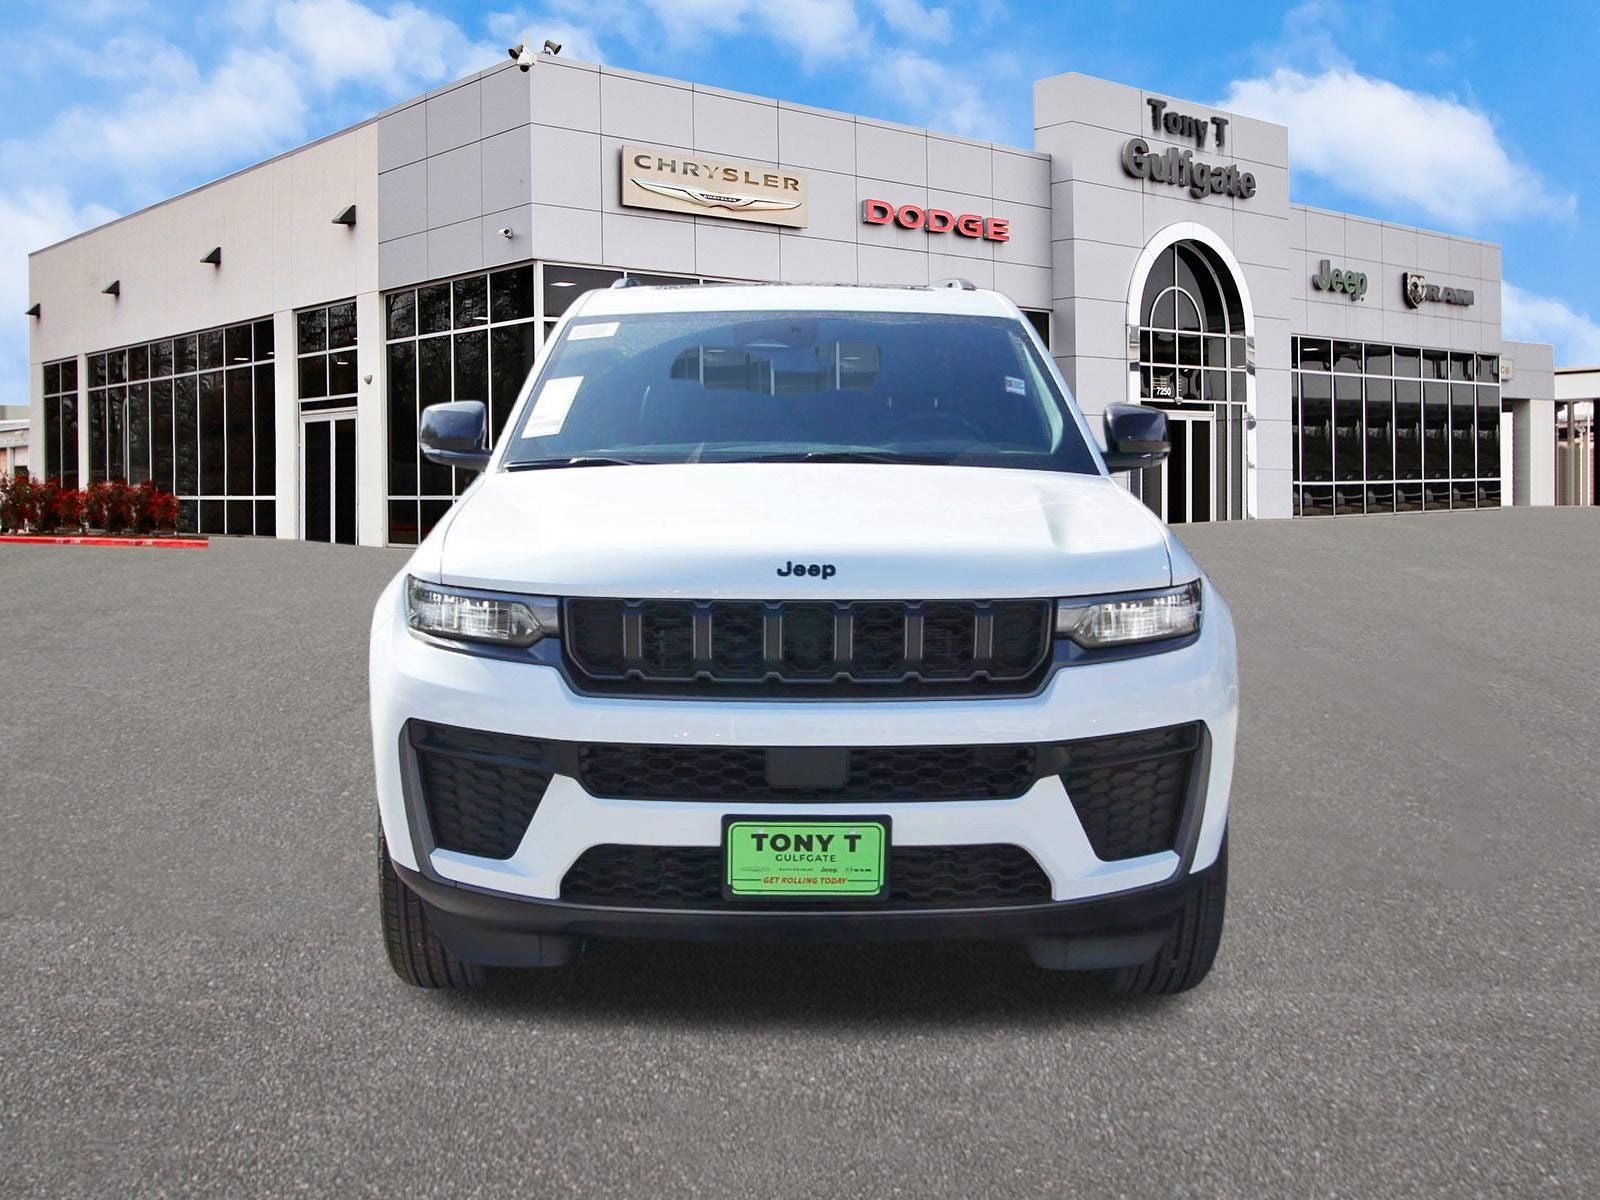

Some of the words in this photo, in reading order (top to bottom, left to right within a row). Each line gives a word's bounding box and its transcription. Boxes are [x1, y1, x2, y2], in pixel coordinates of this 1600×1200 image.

[1147, 98, 1208, 149] Tony
[1210, 116, 1229, 147] T
[633, 153, 801, 192] CHRYSLER
[1121, 137, 1257, 199] Gulfgate
[862, 198, 1011, 243] DODGE
[1312, 259, 1368, 302] Jeep
[1424, 283, 1475, 307] RAM
[1156, 386, 1171, 395] 7250
[776, 560, 837, 580] Jeep
[751, 833, 835, 852] TONY
[844, 834, 862, 852] T
[775, 853, 837, 863] GULFGATE
[763, 876, 779, 884] GET
[781, 876, 818, 885] ROLLING
[820, 876, 848, 885] TODAY
